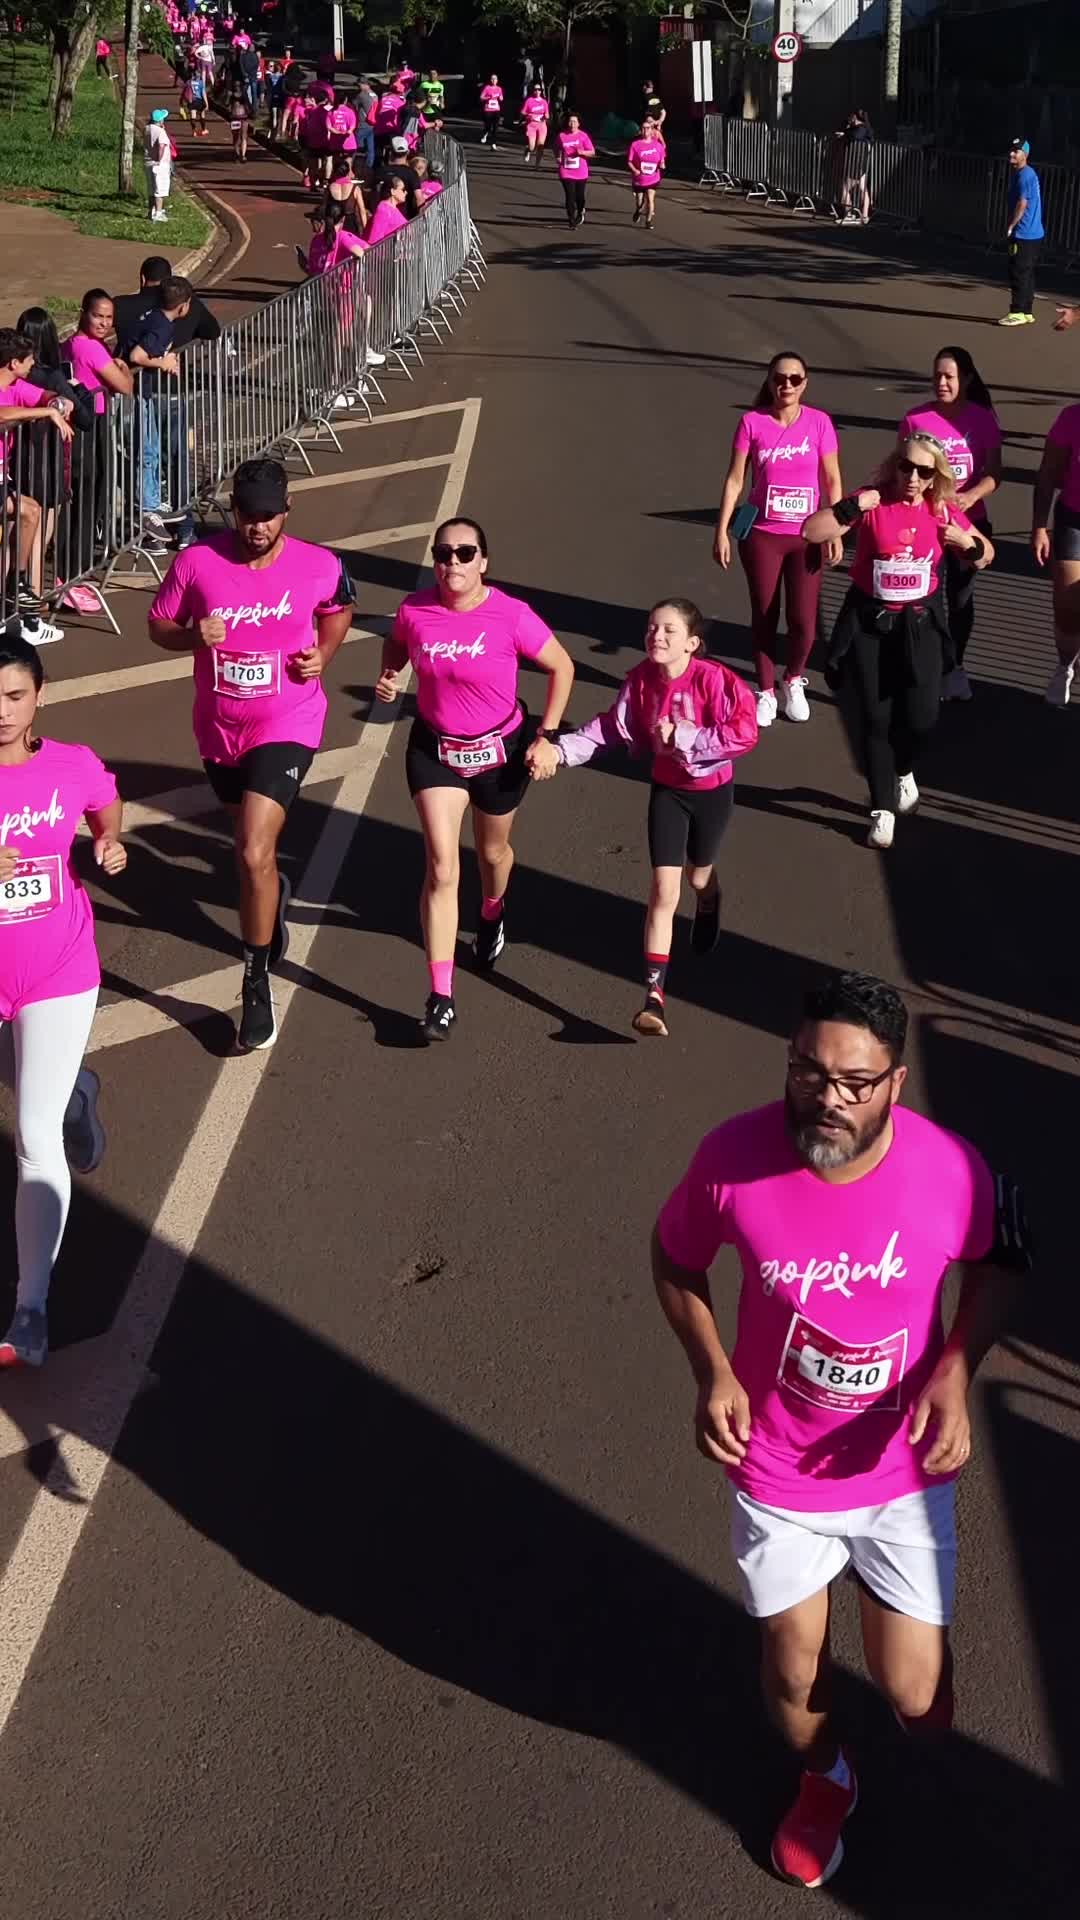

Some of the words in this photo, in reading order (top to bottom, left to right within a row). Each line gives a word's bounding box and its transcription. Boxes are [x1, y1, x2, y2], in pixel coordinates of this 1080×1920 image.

[777, 38, 796, 50] 40
[779, 498, 804, 509] 1609
[886, 575, 917, 586] 1300
[229, 665, 265, 681] 1703
[454, 750, 491, 764] 1859
[760, 1230, 907, 1304] gopink
[813, 1358, 881, 1387] 1840
